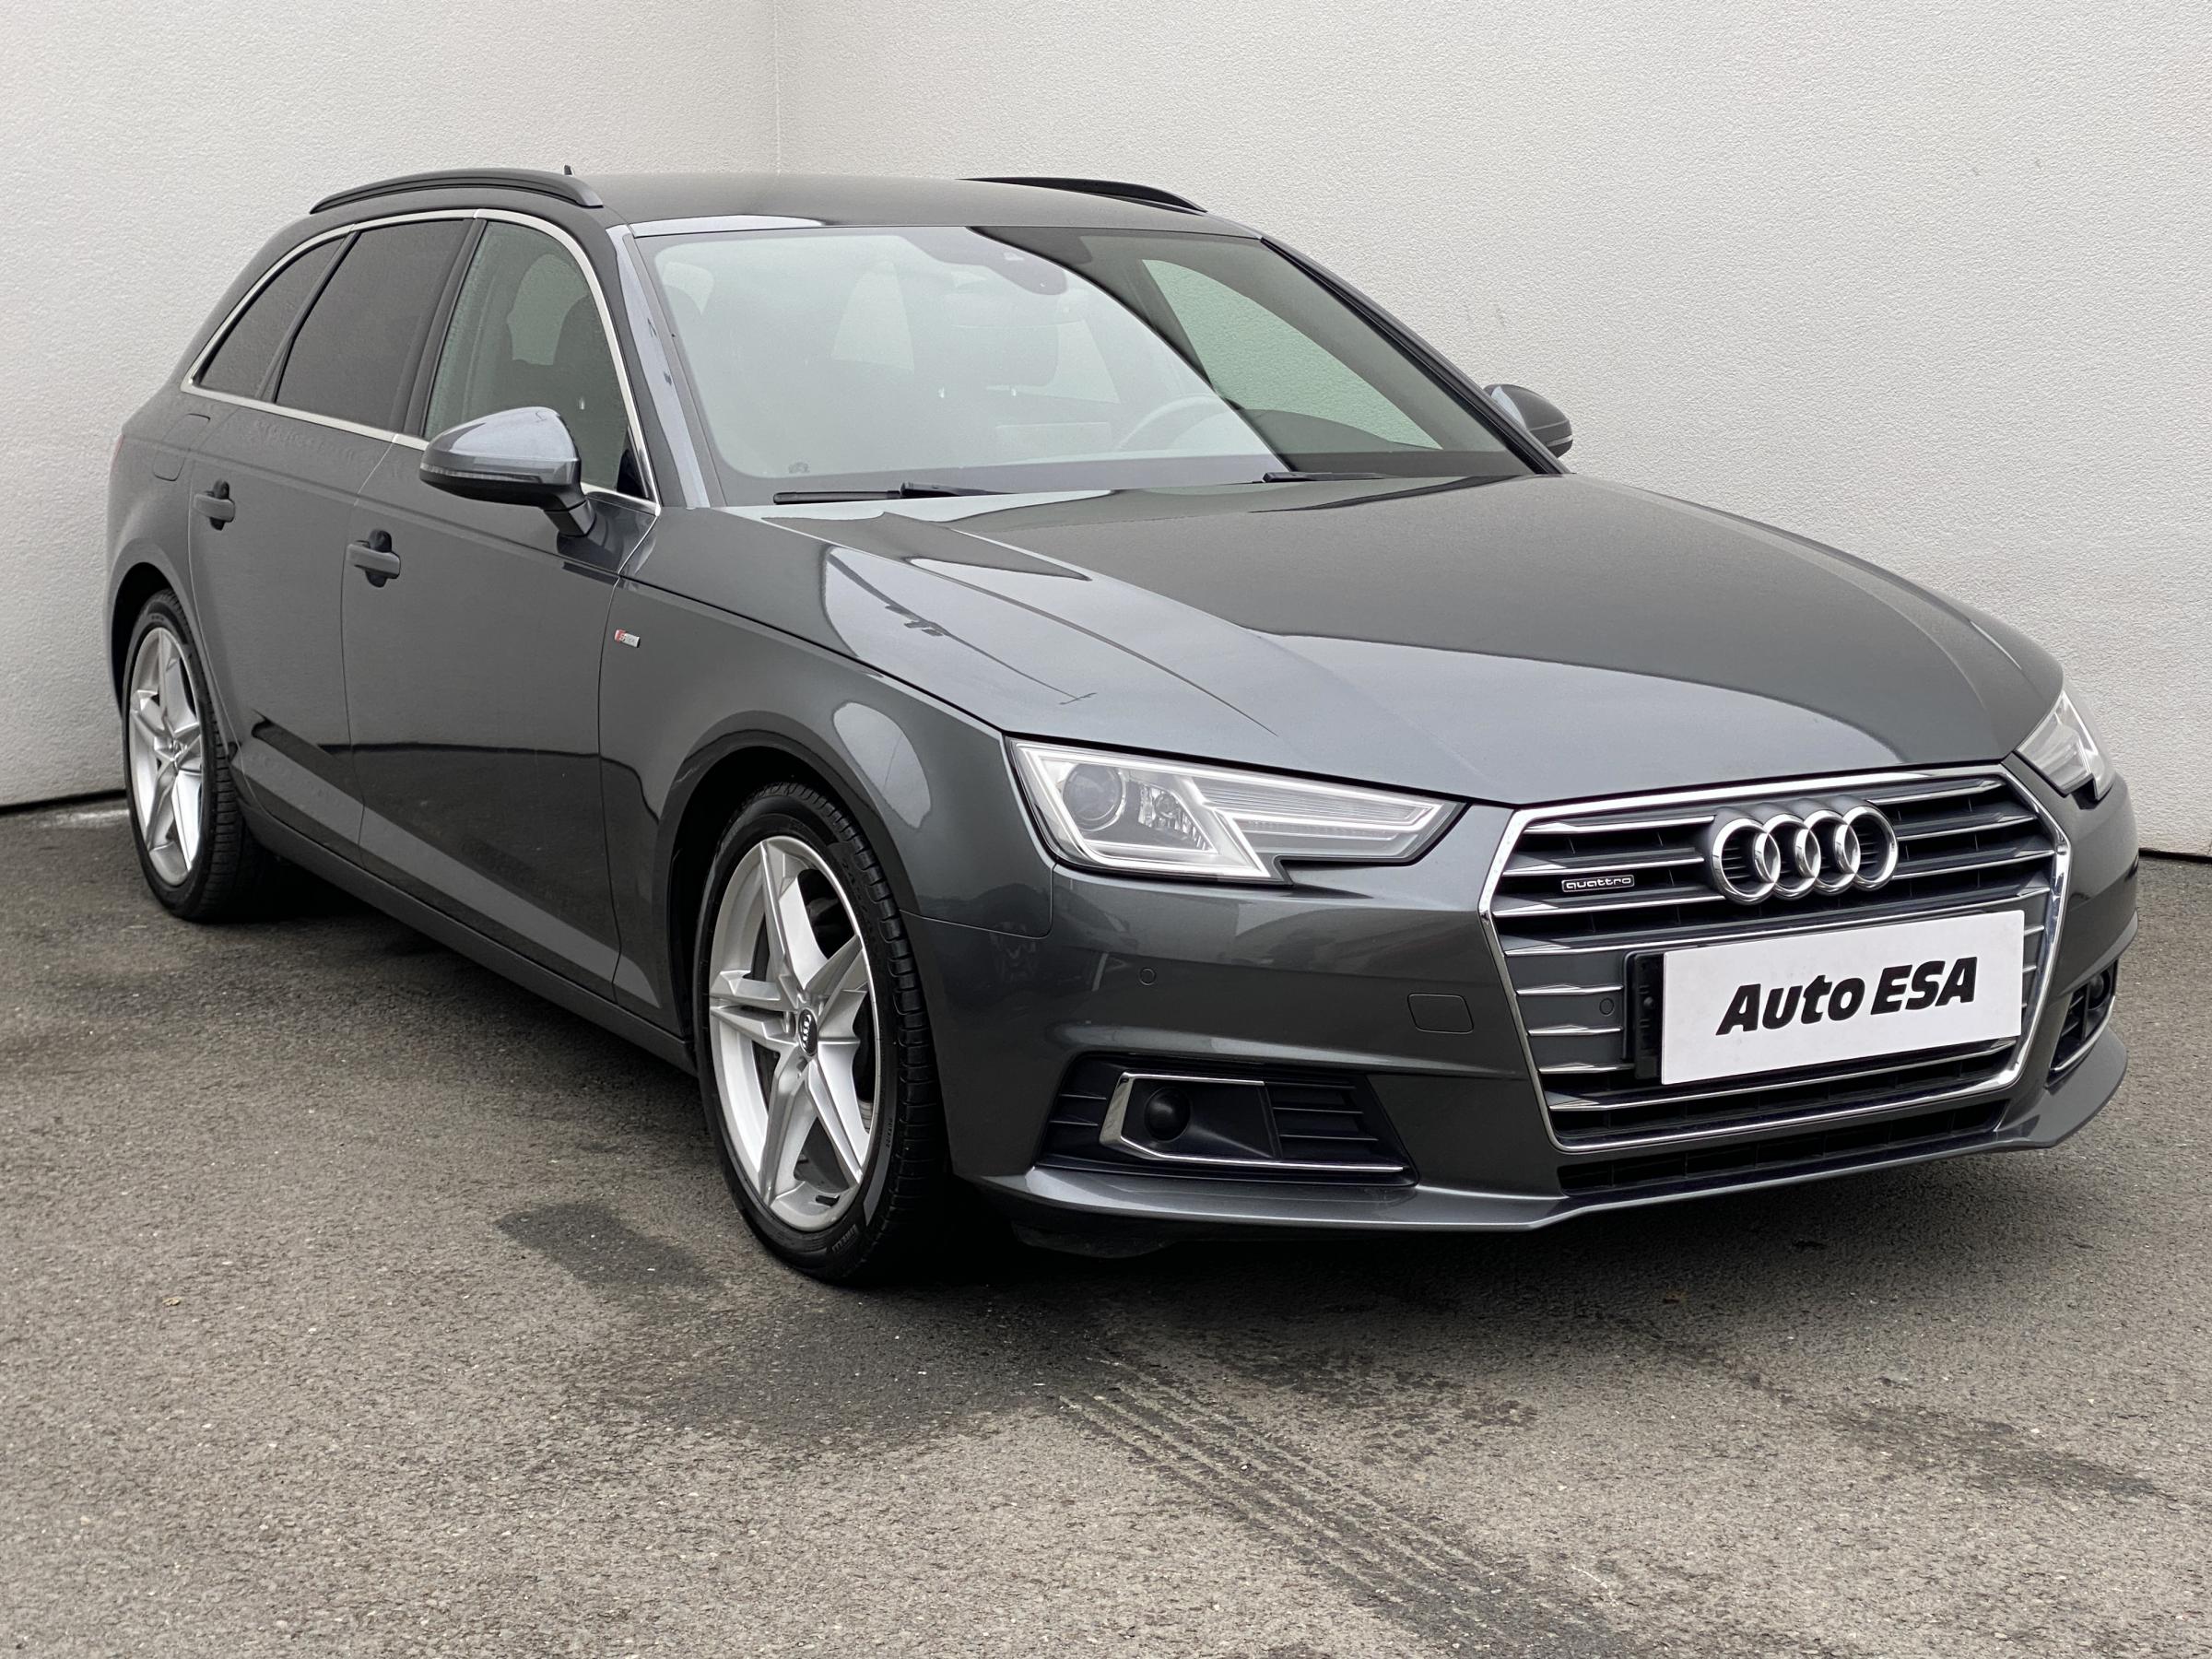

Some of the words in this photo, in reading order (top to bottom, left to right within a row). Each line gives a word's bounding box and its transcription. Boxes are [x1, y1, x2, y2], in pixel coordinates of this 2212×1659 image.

[1565, 877, 1631, 890] quattro
[1715, 974, 1865, 1036] Auto
[1870, 956, 1978, 1016] ESA
